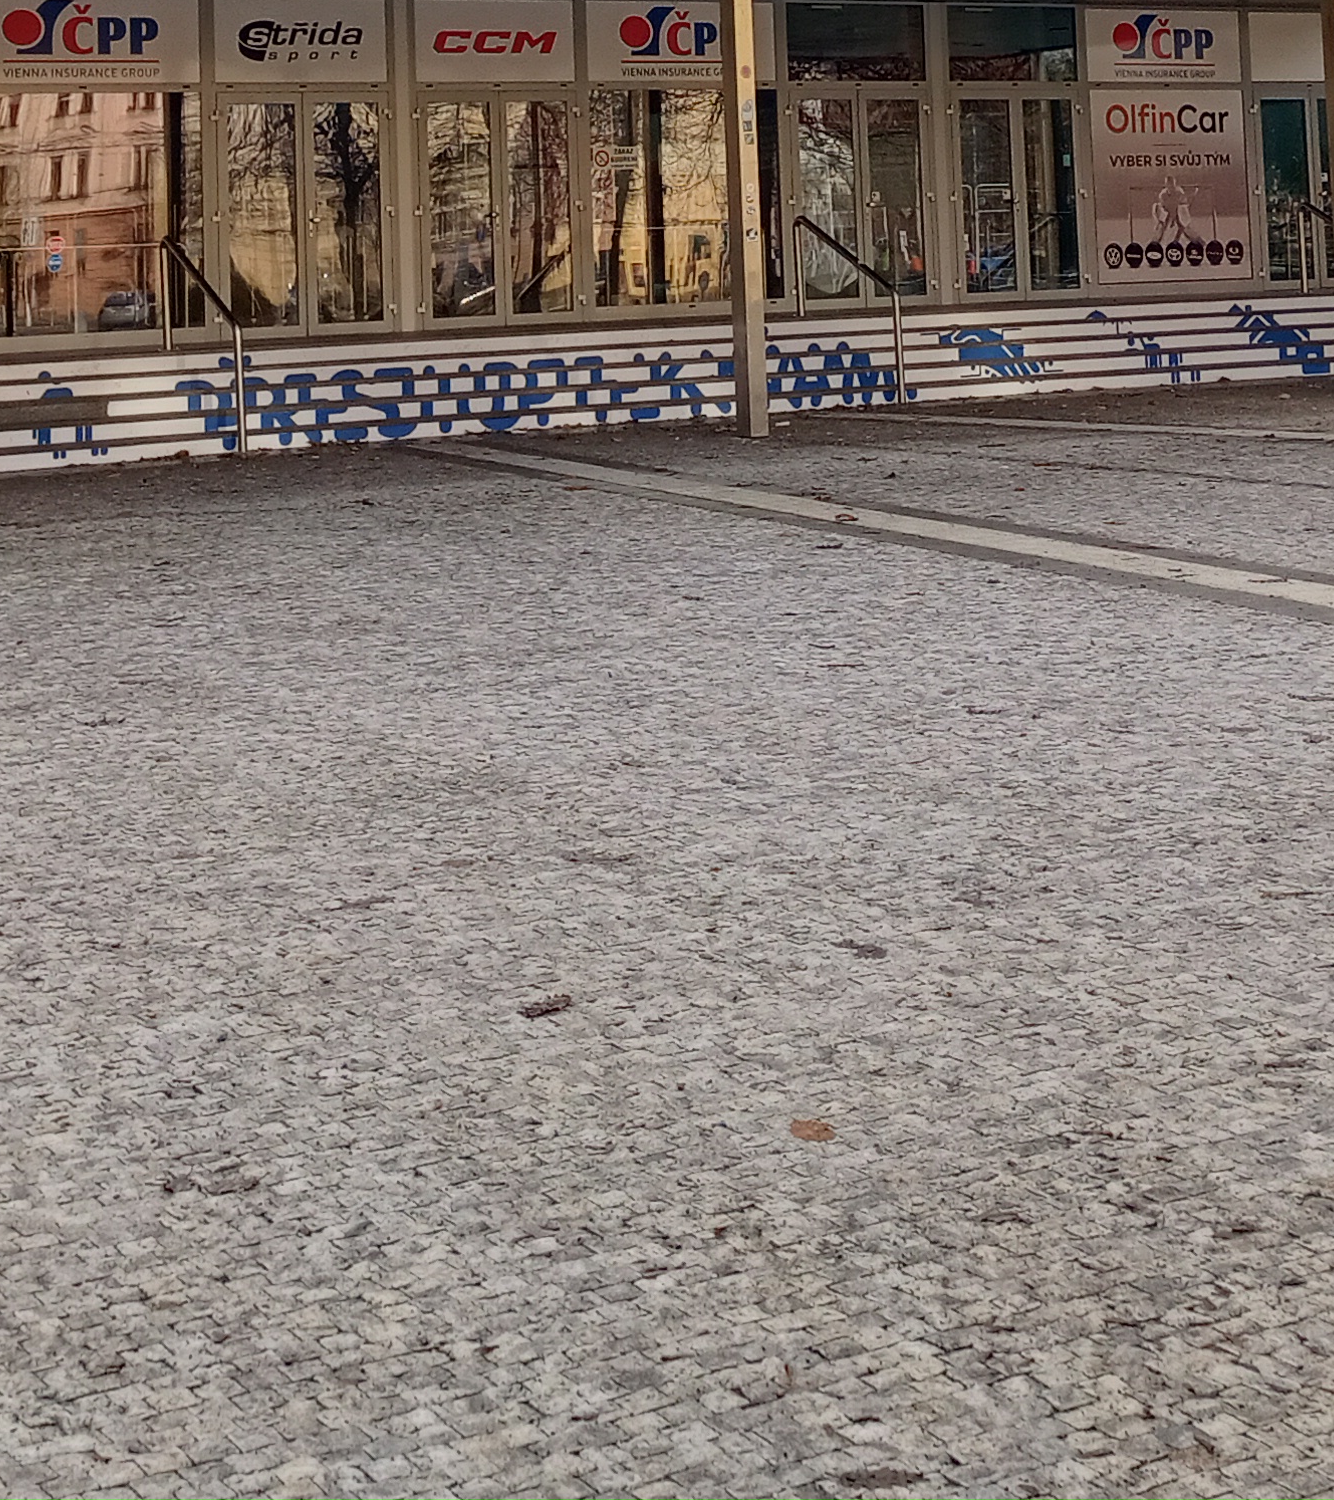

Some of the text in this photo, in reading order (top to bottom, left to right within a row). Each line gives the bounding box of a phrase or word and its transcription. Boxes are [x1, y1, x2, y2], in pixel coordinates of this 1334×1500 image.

[62, 3, 160, 56] ČPP
[666, 10, 719, 57] ČP
[1151, 18, 1215, 61] ČPP
[432, 30, 559, 55] CCM
[267, 49, 360, 64] sport
[2, 67, 161, 79] VIENNA INSURANCE GROUP
[620, 67, 657, 77] VIENNA
[658, 67, 712, 77] INSURANCE
[1114, 68, 1216, 79] VIENNA INSURANCE GROUP
[1105, 103, 1229, 134] OlfinCar
[1109, 149, 1231, 168] VYBER SI SVŮJ TÝM
